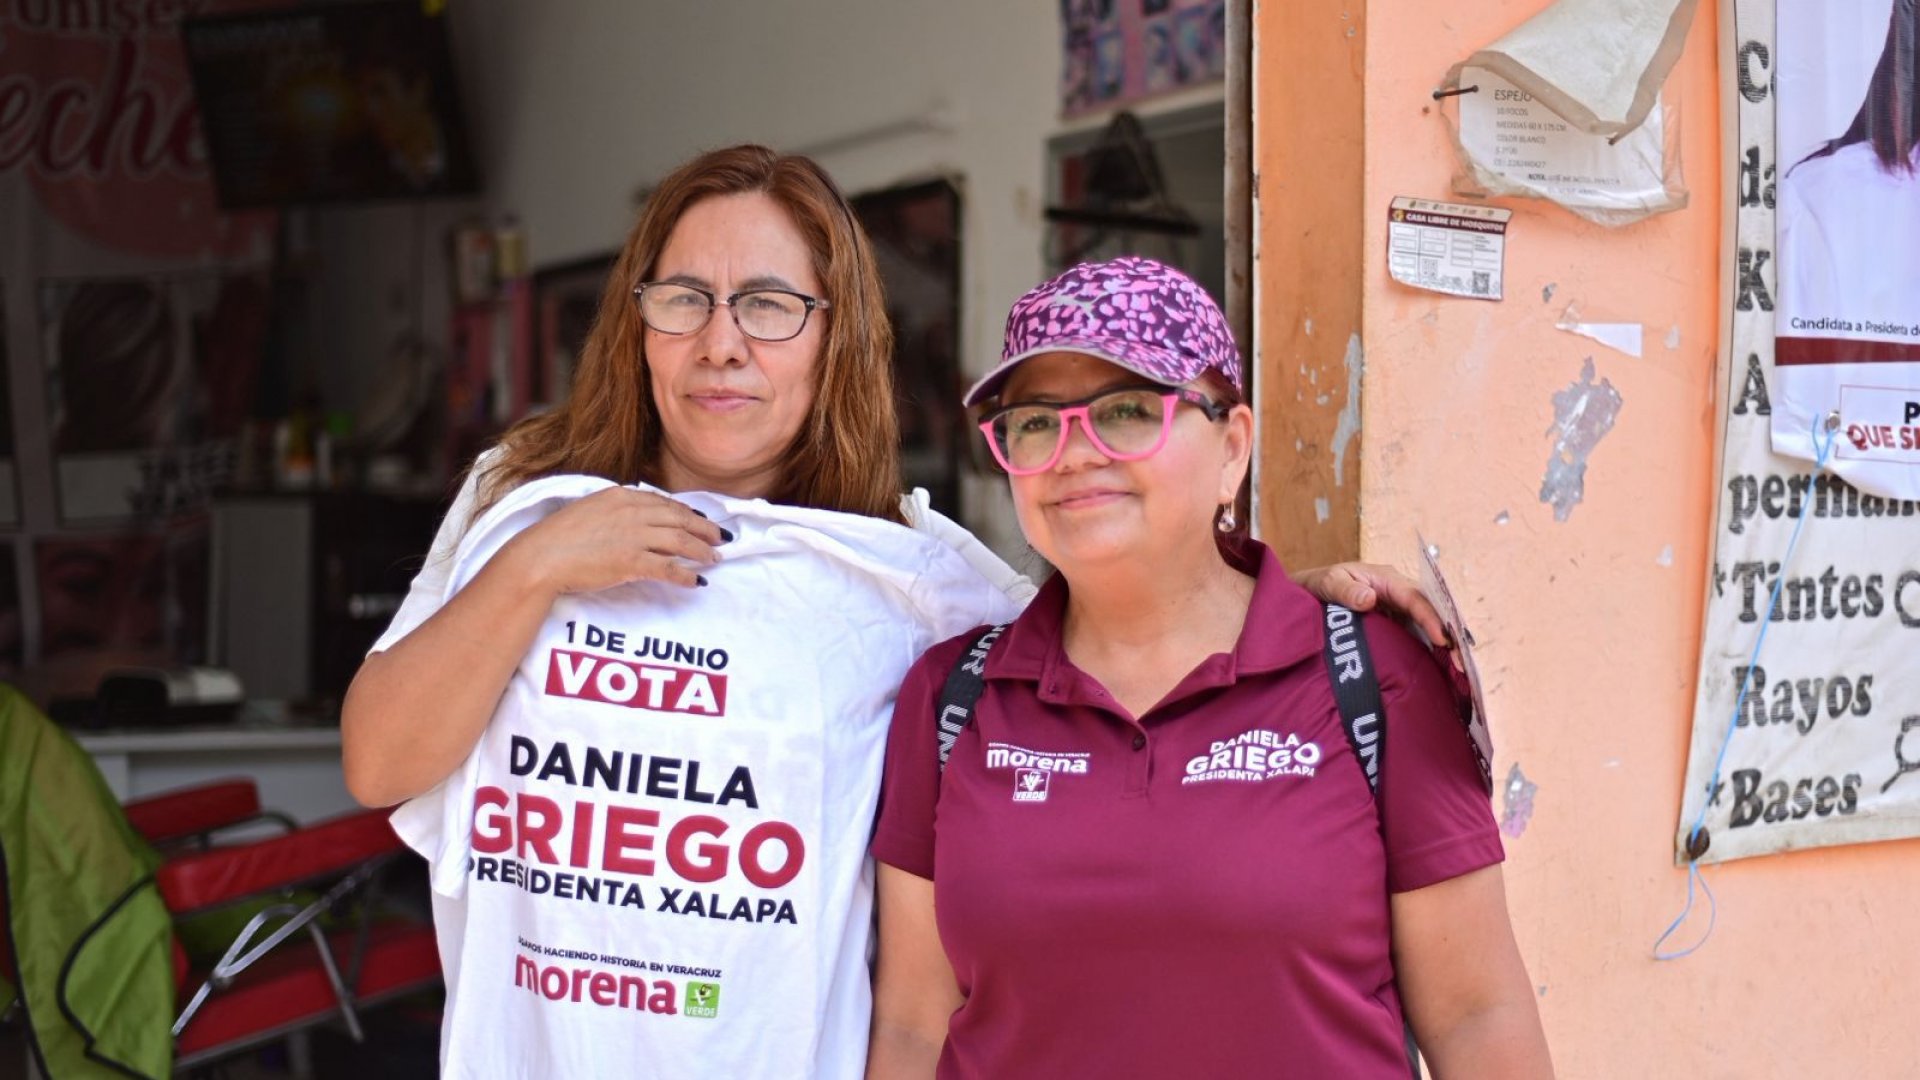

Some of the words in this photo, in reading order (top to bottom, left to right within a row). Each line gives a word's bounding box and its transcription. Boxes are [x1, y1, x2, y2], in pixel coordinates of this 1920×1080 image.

[1738, 40, 1777, 104] C
[1494, 89, 1533, 102] ESPEJO
[1496, 120, 1527, 129] MEDIDAS
[1496, 134, 1518, 142] COLOR
[1519, 135, 1546, 144] BLANCO
[1406, 212, 1427, 223] CASA
[1427, 215, 1449, 225] LIBRE
[1450, 218, 1460, 227] DE
[1461, 219, 1504, 232] MOSQUITOS
[1791, 317, 1853, 331] Candidata
[1855, 322, 1862, 331] a
[1910, 323, 1920, 336] d
[1733, 352, 1772, 416] A
[1904, 401, 1920, 425] P
[1846, 424, 1896, 451] QUE
[1731, 560, 1885, 624] Tintes
[566, 621, 575, 644] 1
[585, 624, 627, 654] DE
[634, 636, 729, 671] JUNIO
[556, 651, 720, 714] VOTA
[1327, 604, 1364, 684] OUR
[1352, 713, 1379, 788] UN
[1732, 664, 1874, 735] Rayos
[938, 704, 968, 771] UN
[1210, 729, 1300, 754] DANIELA
[510, 734, 760, 810] DANIELA
[986, 749, 1088, 774] morena
[1181, 769, 1263, 785] PRESIDENTA
[1266, 765, 1315, 779] XALAPA
[1185, 742, 1321, 775] GRIEGO
[1730, 768, 1862, 829] Bases
[471, 785, 806, 889] GRIEGO
[656, 886, 799, 925] XALAPA
[544, 947, 598, 962] HACIENDO
[600, 954, 647, 970] HISTORIA
[650, 962, 663, 973] EN
[666, 964, 723, 978] VERACRUZ
[515, 953, 678, 1016] morena
[686, 1007, 716, 1017] VERDE
